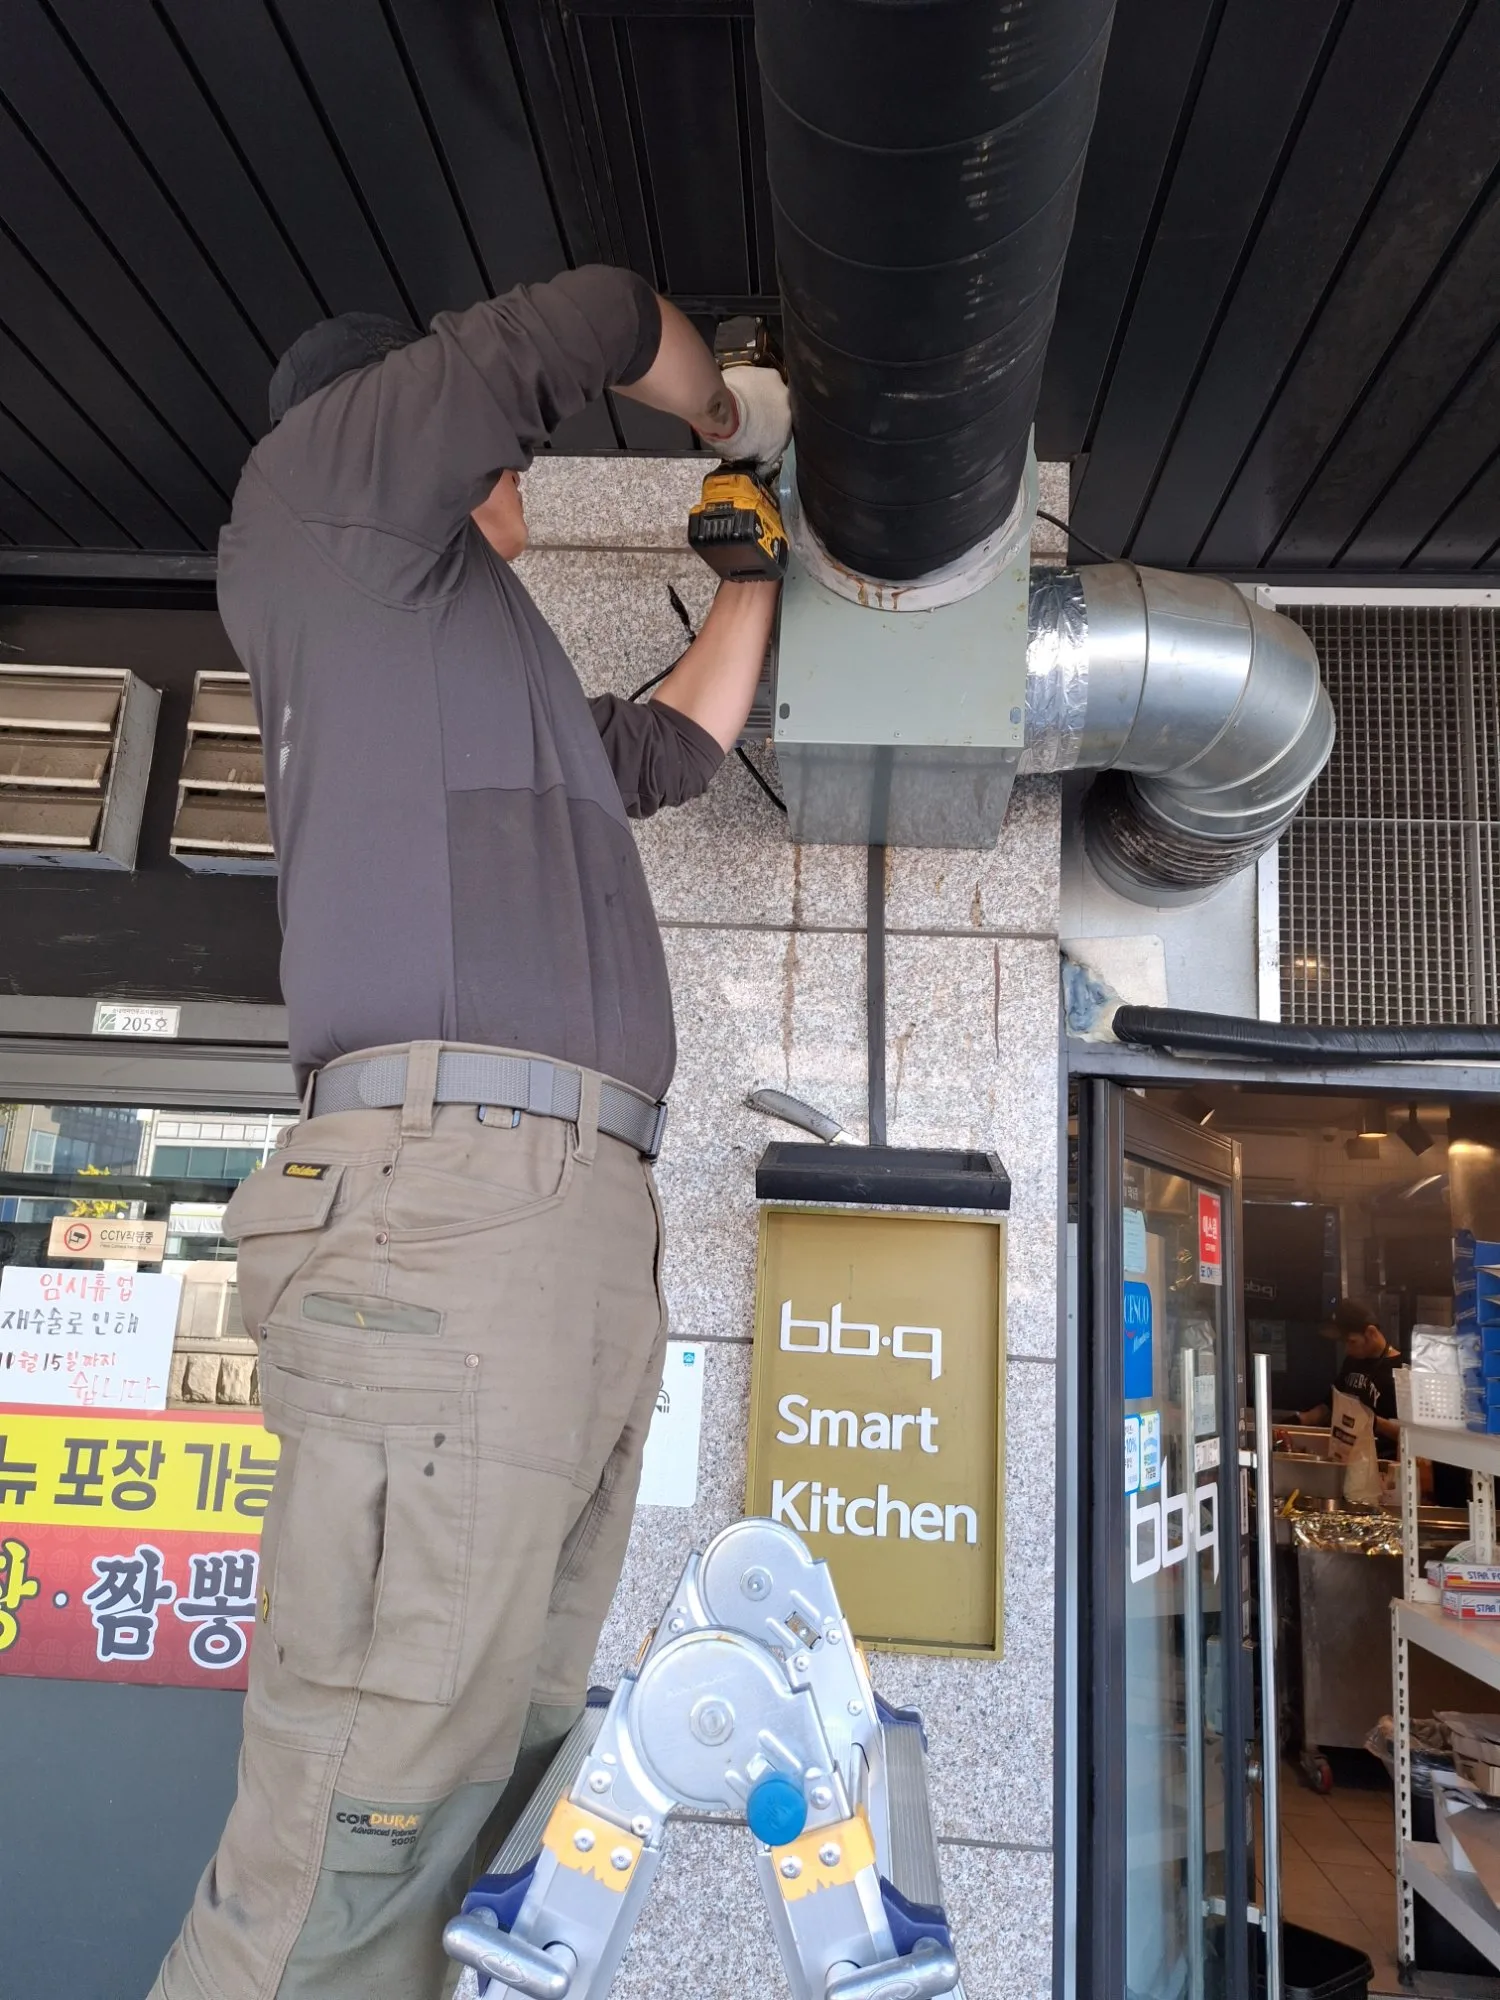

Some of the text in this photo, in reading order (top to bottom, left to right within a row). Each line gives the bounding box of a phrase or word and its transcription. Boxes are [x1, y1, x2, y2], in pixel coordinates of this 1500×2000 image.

[122, 1016, 168, 1032] 205호
[775, 1394, 939, 1454] Smart
[54, 1437, 166, 1511] 포장
[184, 1442, 280, 1517] 가능
[771, 1480, 978, 1545] Kitchen
[84, 1545, 259, 1668] 짬뽕
[336, 1812, 418, 1828] CORDURA
